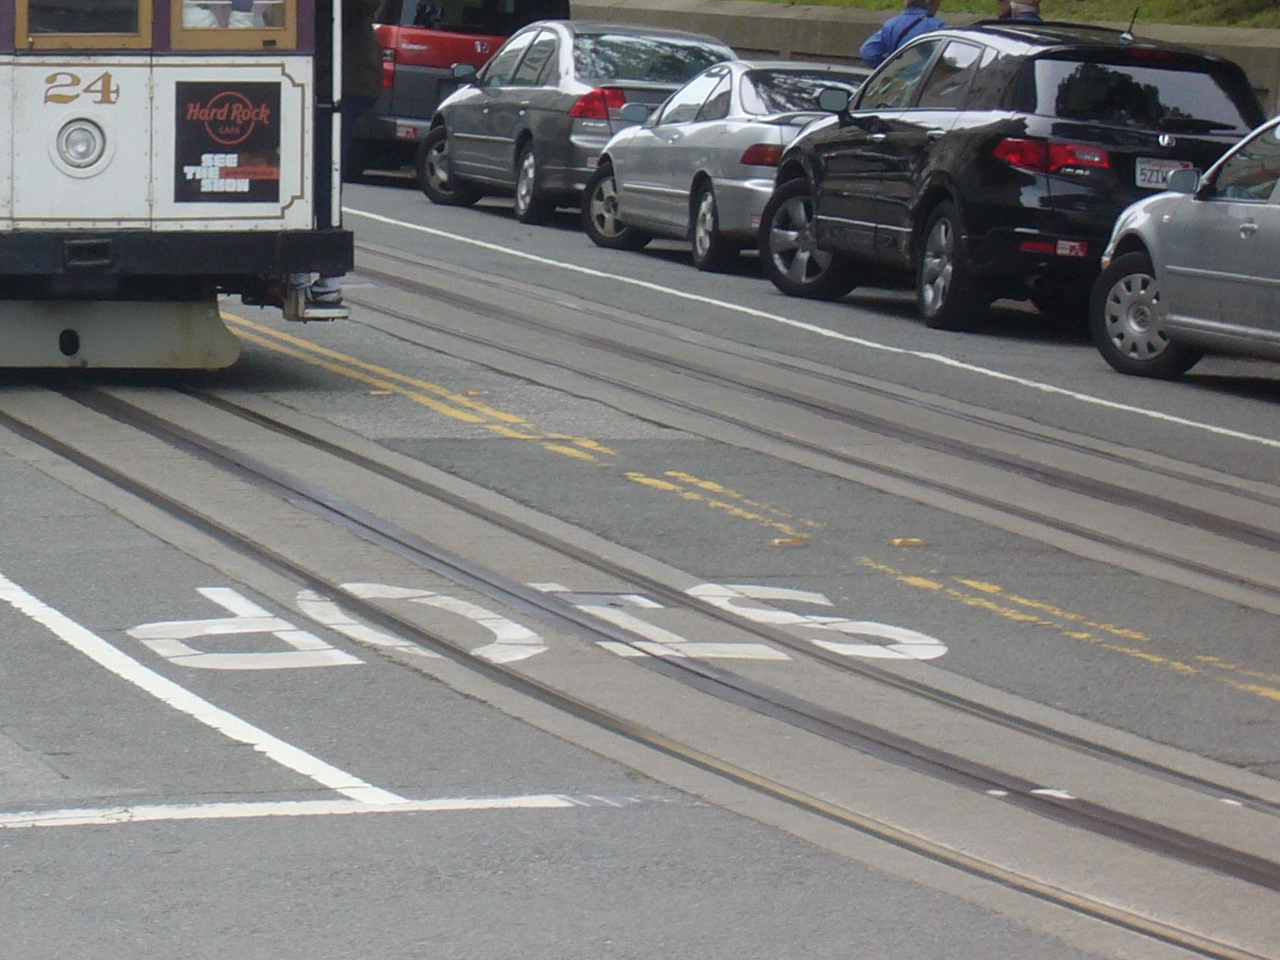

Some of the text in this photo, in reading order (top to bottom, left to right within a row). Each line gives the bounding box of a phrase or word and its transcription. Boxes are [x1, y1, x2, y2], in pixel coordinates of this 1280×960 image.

[44, 71, 120, 105] 24
[186, 102, 271, 125] Hard Rock
[201, 153, 239, 167] SEE
[183, 166, 220, 180] THE
[200, 178, 250, 192] SHOW
[126, 581, 949, 671] STOP
